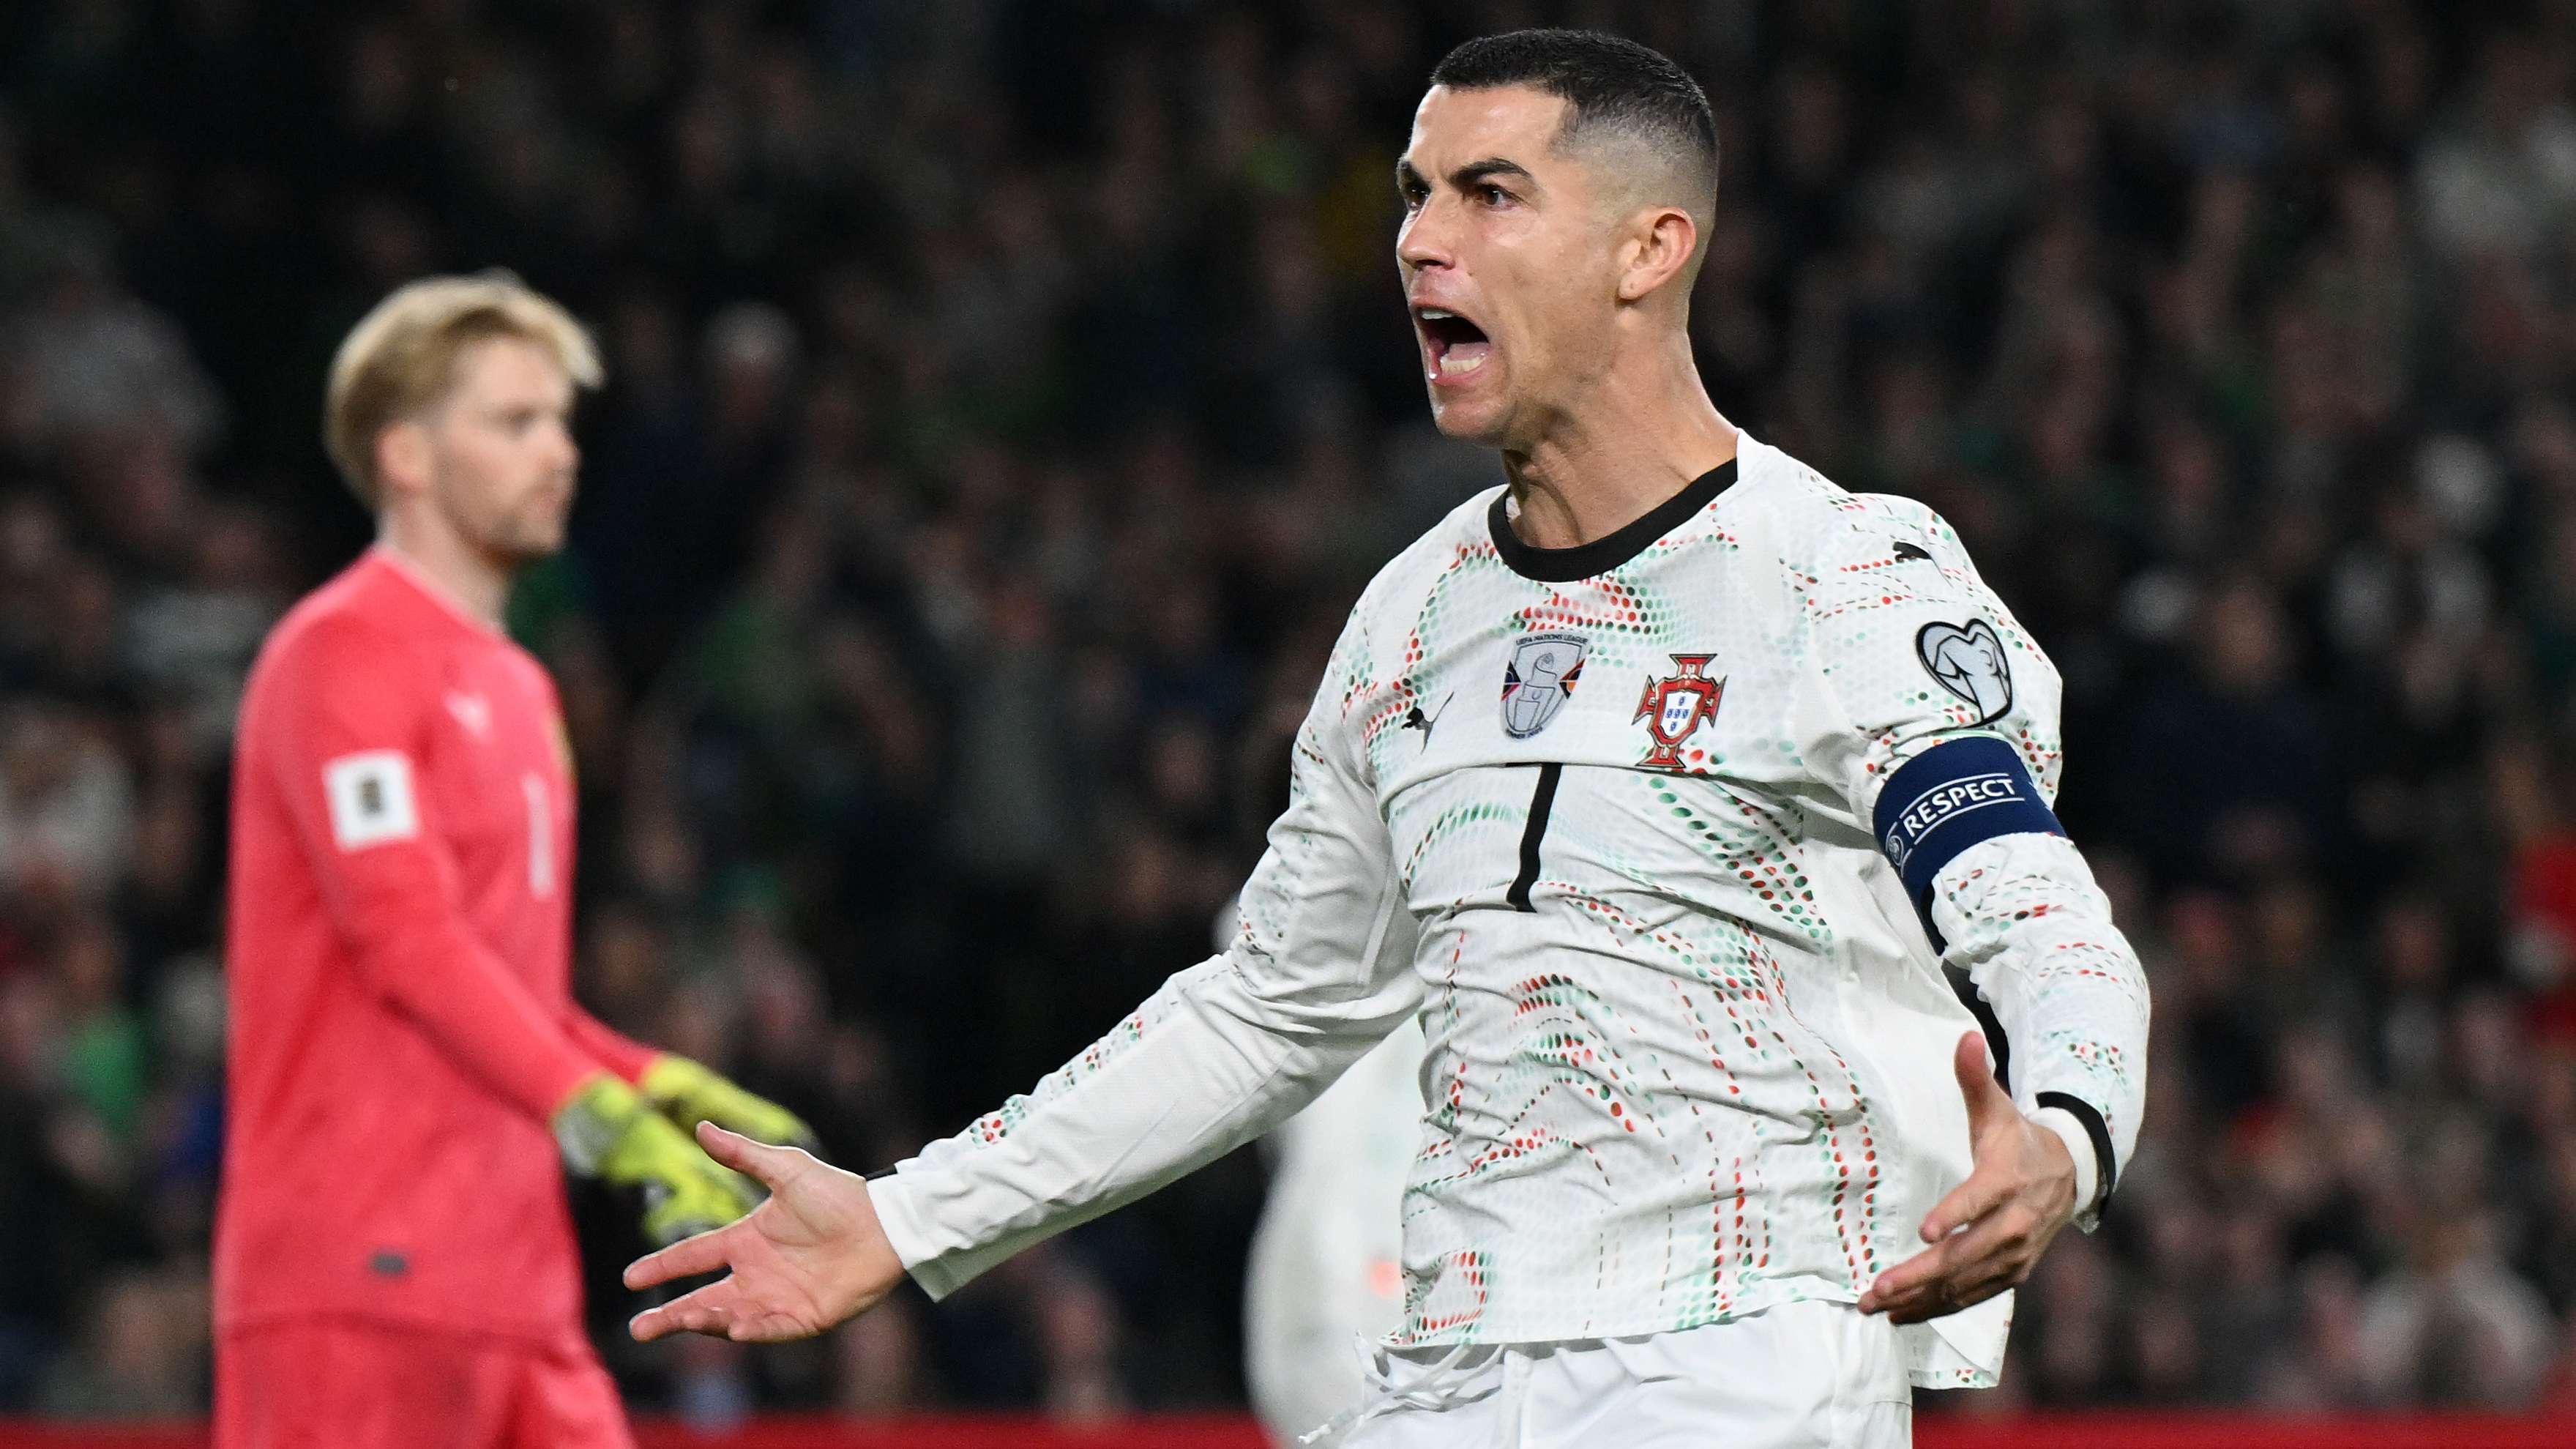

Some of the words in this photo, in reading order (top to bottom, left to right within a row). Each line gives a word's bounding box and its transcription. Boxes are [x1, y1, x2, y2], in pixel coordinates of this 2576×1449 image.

[1516, 637, 1532, 645] UEFA
[1564, 635, 1588, 644] LEAGUE
[1505, 762, 1564, 912] 7
[1903, 779, 2015, 838] RESPECT
